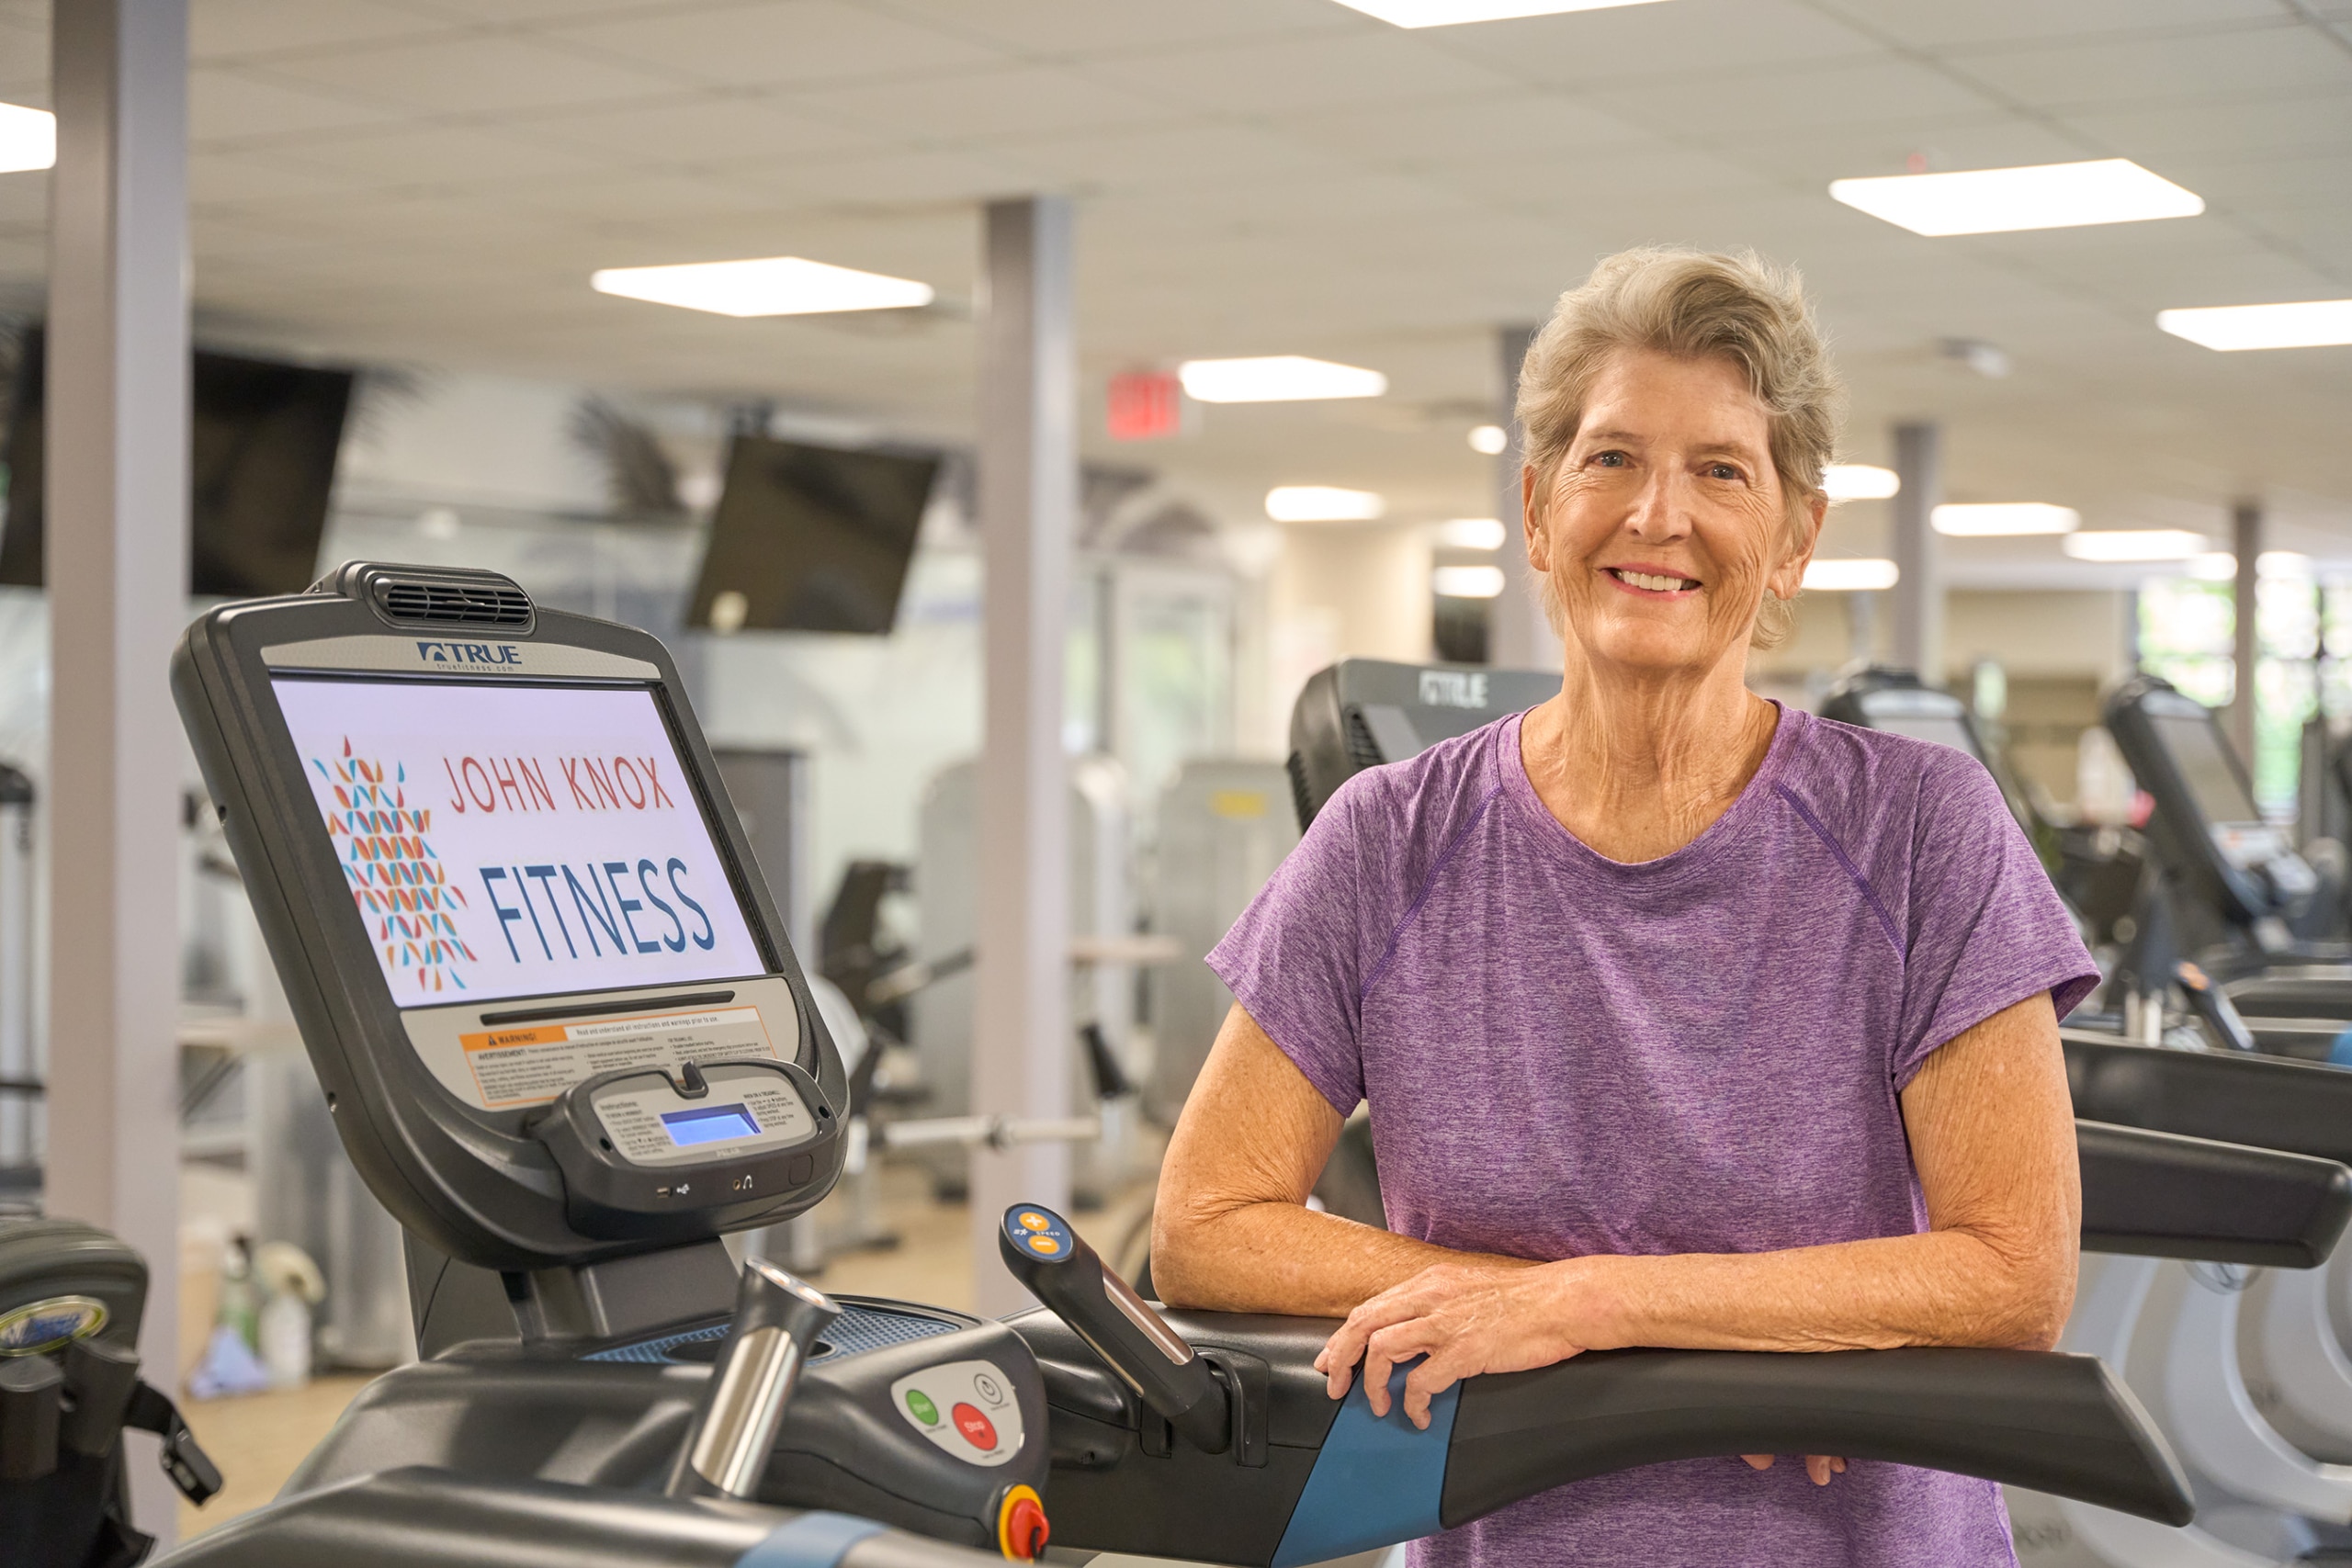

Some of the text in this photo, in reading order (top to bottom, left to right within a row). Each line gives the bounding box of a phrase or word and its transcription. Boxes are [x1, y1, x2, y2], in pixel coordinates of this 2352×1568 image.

[443, 643, 522, 664] TRUE
[444, 756, 674, 814] JOHN KNOX
[479, 857, 716, 964] FITNESS
[576, 1028, 589, 1036] Read
[589, 1027, 598, 1035] and
[599, 1024, 625, 1035] understand
[633, 1021, 661, 1032] instructions
[662, 1021, 671, 1029] and
[671, 1019, 691, 1028] warnings
[692, 1018, 703, 1026] prior
[498, 1032, 537, 1044] WARNING!
[964, 1420, 986, 1433] Stop
